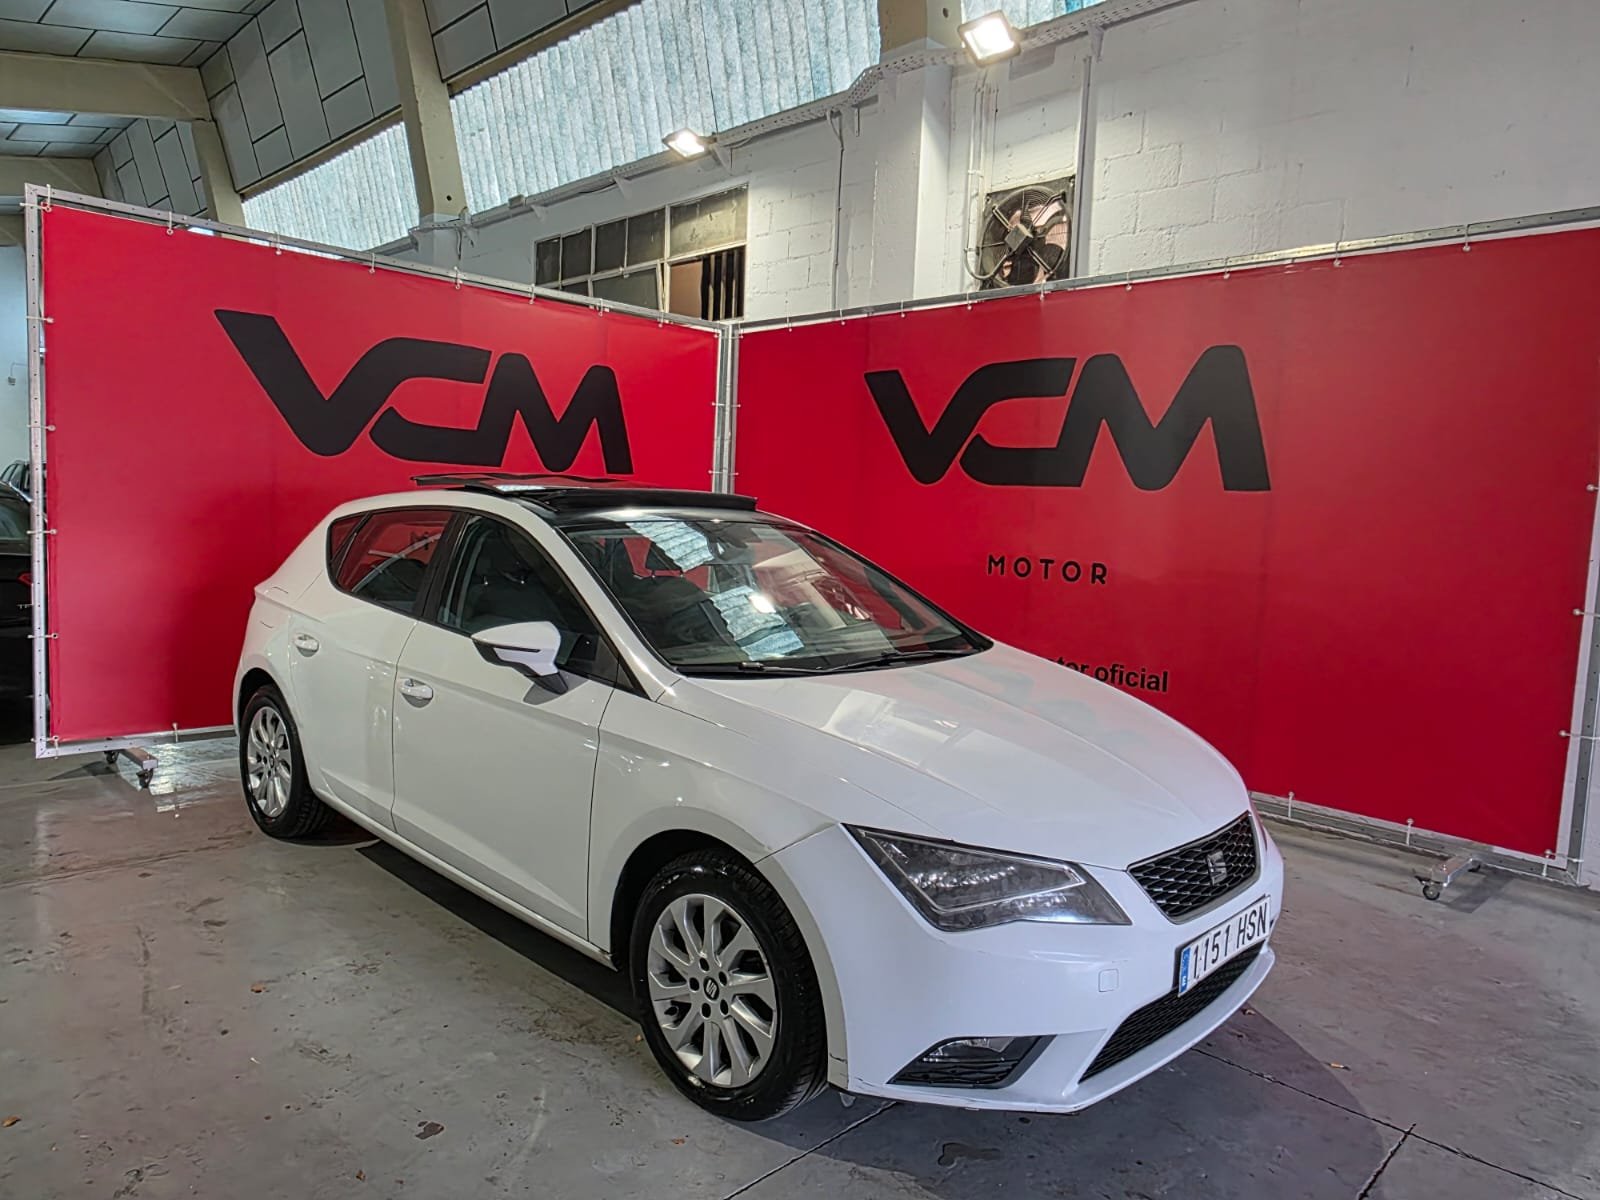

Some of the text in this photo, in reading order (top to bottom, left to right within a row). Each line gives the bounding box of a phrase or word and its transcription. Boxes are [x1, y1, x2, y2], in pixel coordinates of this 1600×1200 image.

[214, 309, 634, 475] VCM
[864, 345, 1271, 491] VCM
[987, 554, 1108, 585] MOTOR
[1094, 663, 1169, 693] oficial
[1193, 902, 1268, 979] 1151 HSN
